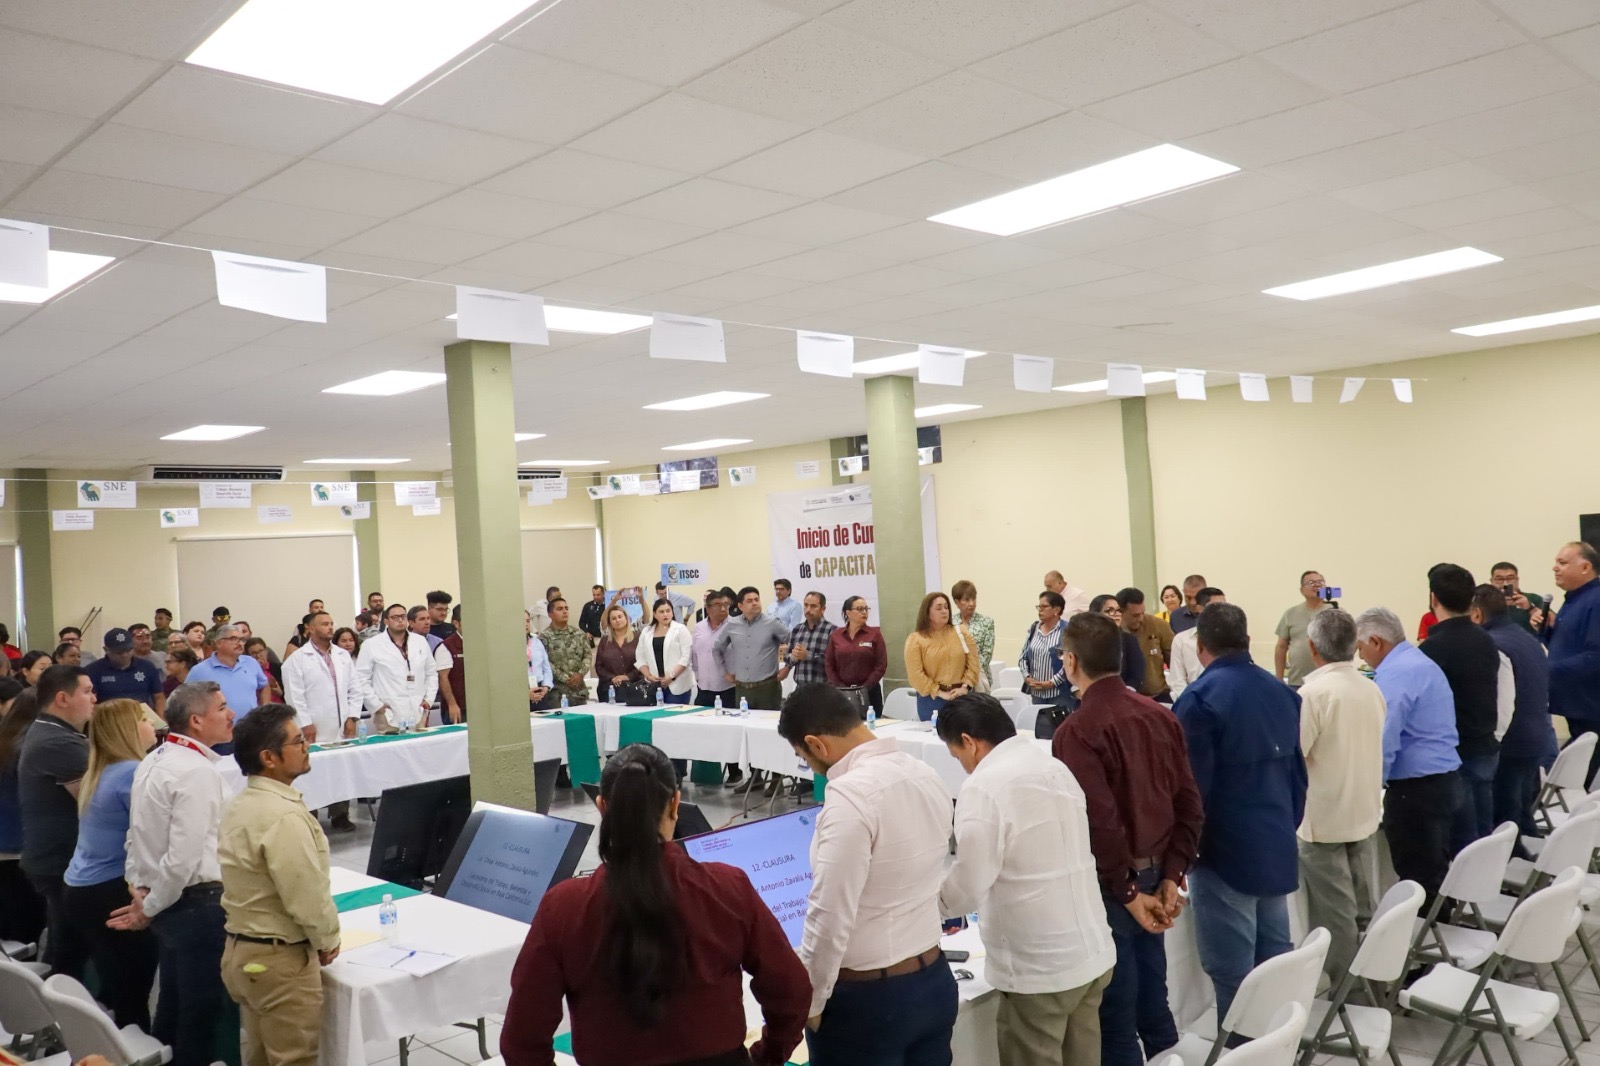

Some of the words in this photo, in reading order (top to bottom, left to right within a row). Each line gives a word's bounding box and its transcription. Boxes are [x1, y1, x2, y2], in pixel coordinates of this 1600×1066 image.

[104, 482, 126, 491] SNE
[332, 483, 350, 491] SNE
[797, 526, 830, 549] Inicio
[834, 524, 849, 546] de
[800, 561, 811, 578] de
[814, 554, 876, 578] CAPACITA
[680, 569, 699, 579] ITSCC
[761, 880, 784, 892] Antonio
[784, 875, 804, 886] Zavala
[772, 904, 782, 913] del
[782, 898, 806, 909] Trabajo,
